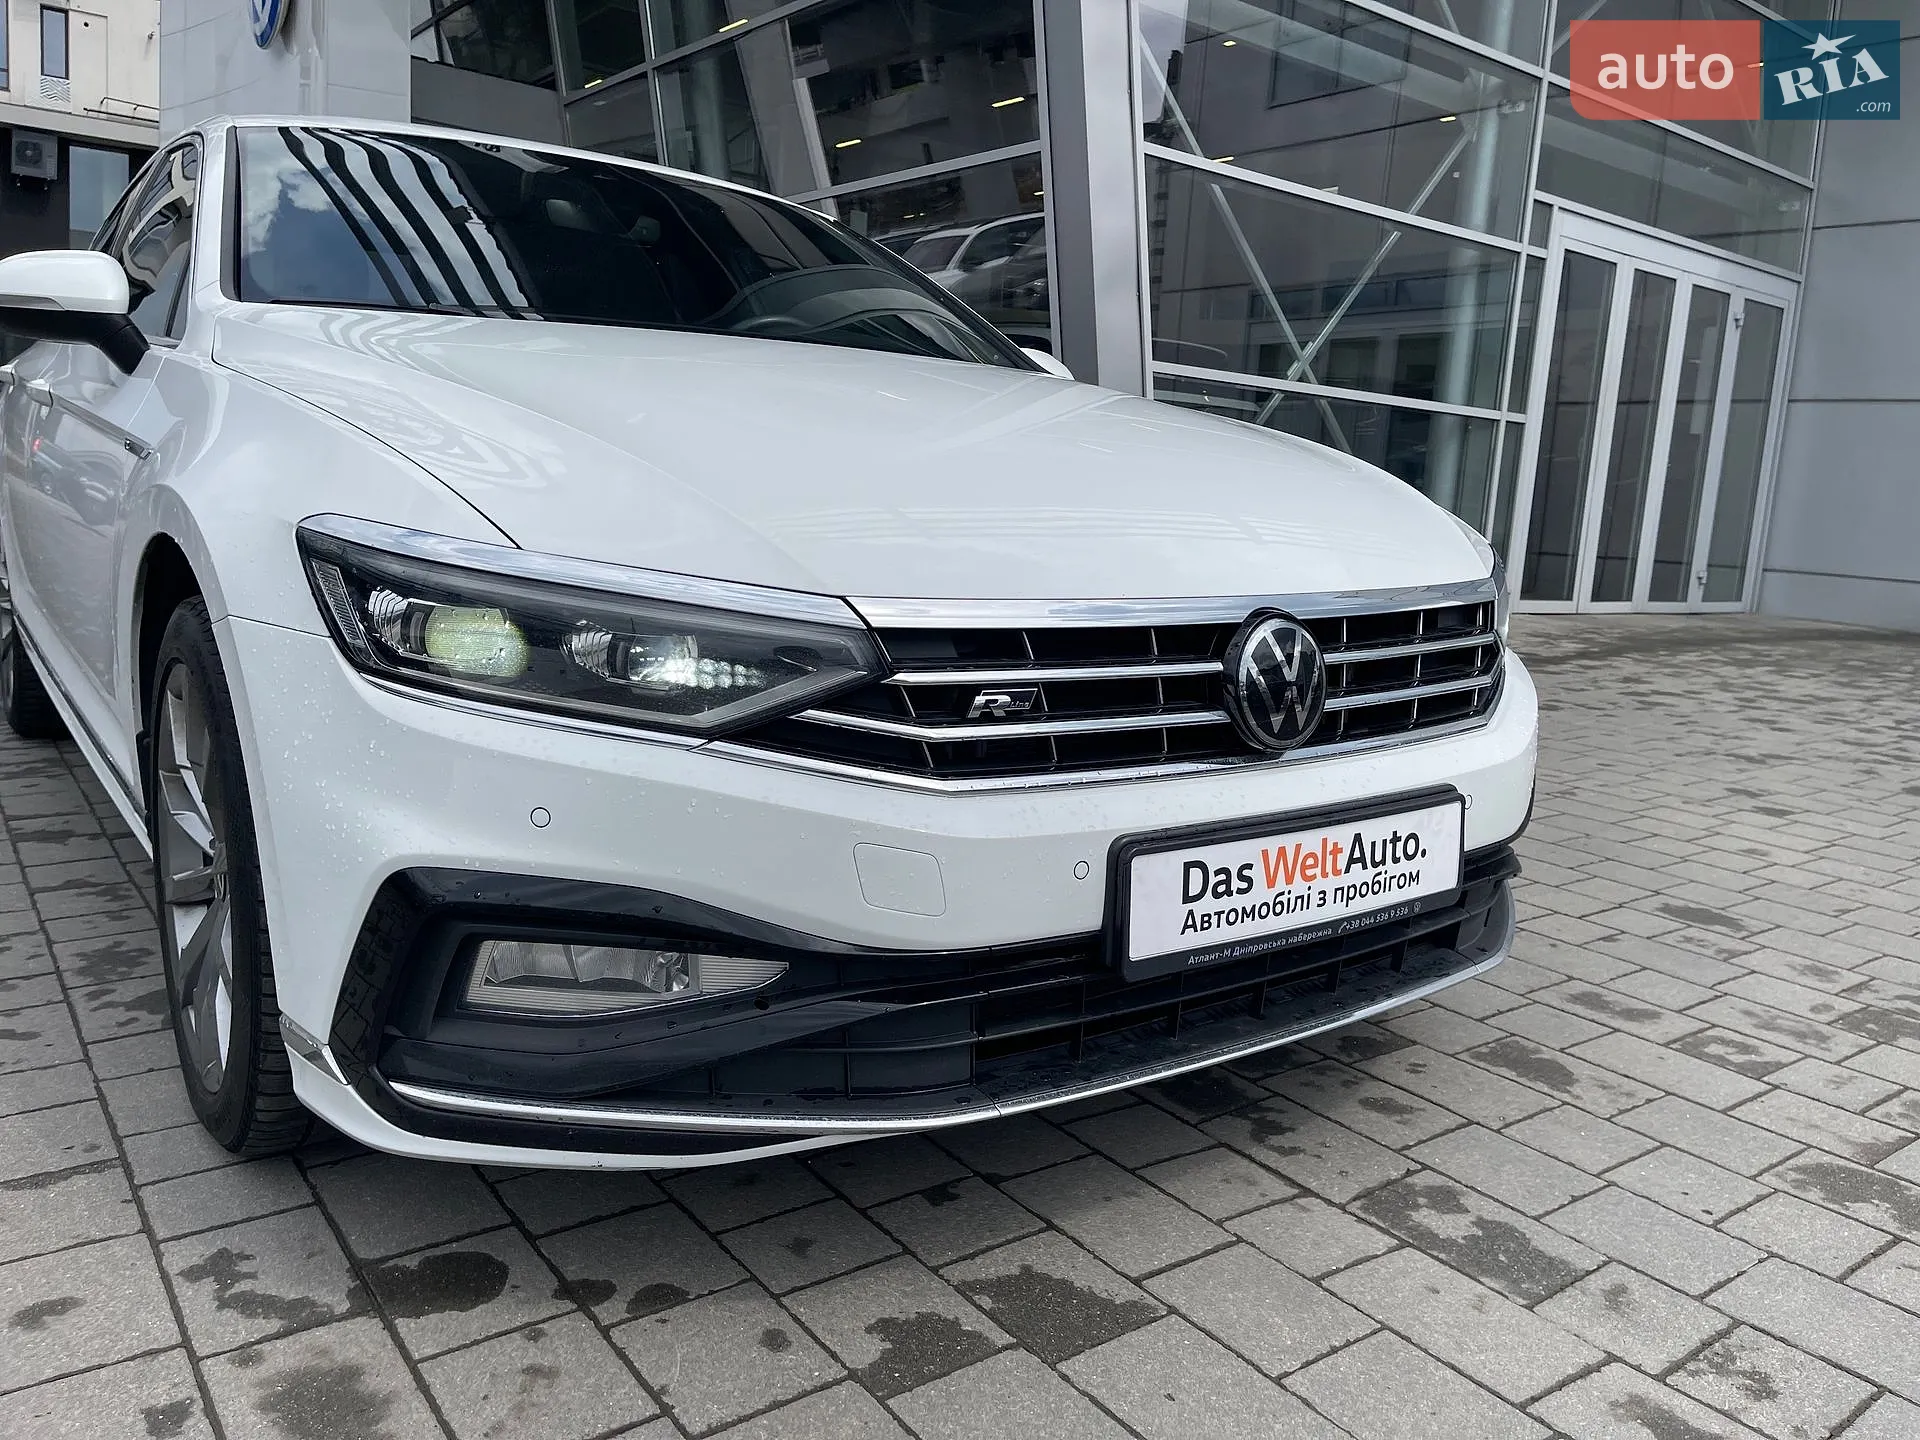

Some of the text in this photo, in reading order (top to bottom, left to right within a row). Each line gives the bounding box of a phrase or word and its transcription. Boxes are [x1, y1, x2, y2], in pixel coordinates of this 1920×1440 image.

[1180, 869, 1421, 936] Автомобілі з пробігом
[1181, 859, 1254, 905] Das
[1187, 948, 1232, 966] Атлант-М
[1287, 927, 1333, 945] набережна
